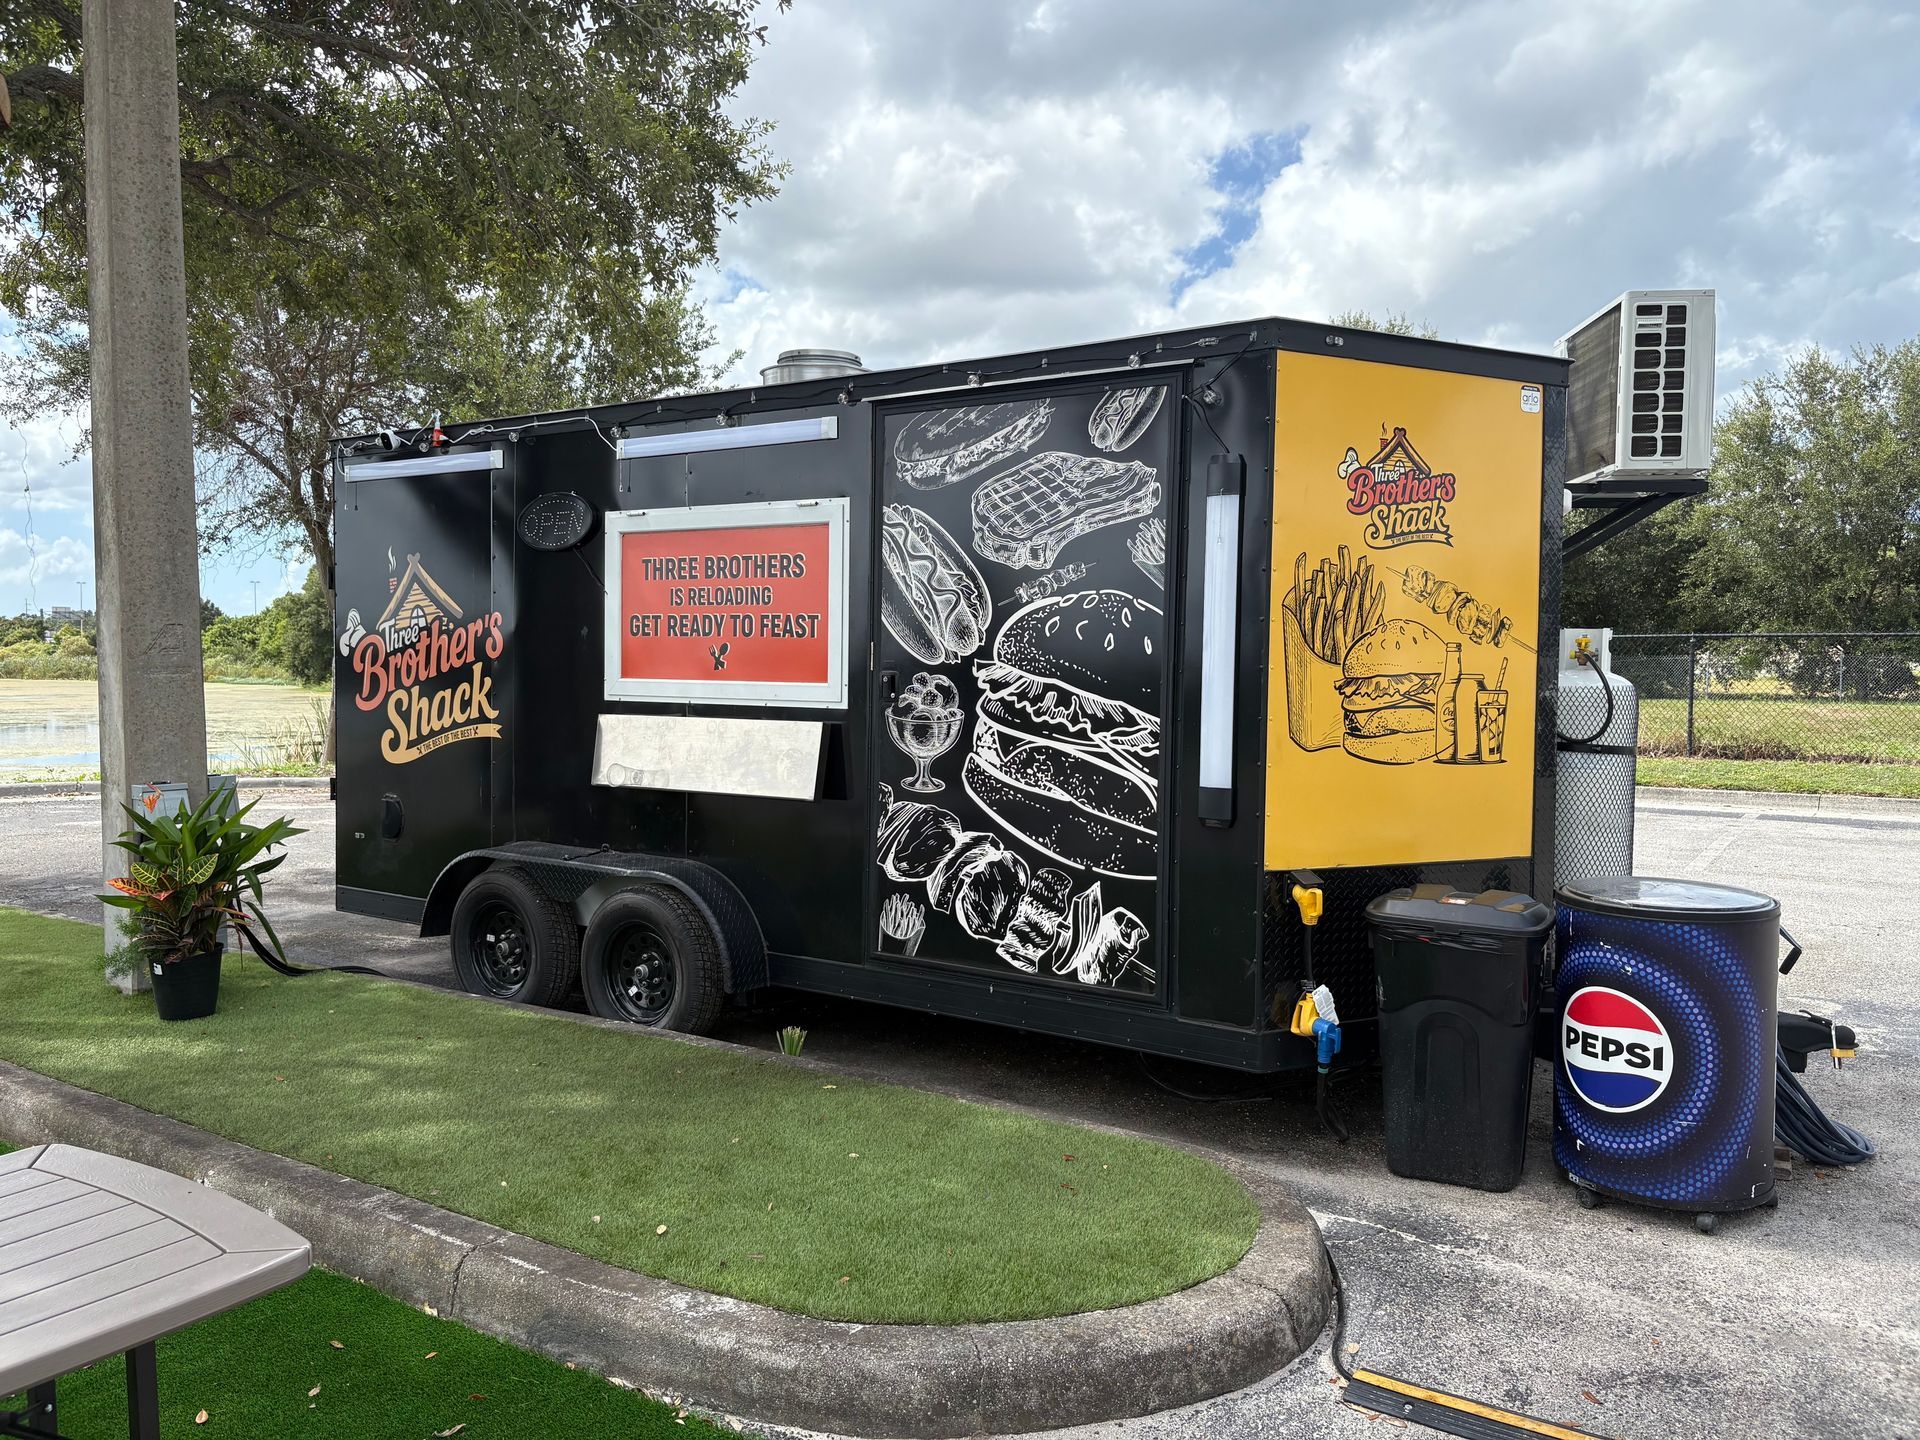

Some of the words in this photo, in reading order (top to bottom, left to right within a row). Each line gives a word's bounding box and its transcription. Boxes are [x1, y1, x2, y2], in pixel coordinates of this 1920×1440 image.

[1370, 463, 1400, 482] Three
[1347, 469, 1455, 514] Brother's
[525, 510, 581, 536] OPEN
[1365, 501, 1449, 549] Shack
[642, 556, 699, 581] THREE
[704, 553, 806, 579] BROTHERS
[670, 587, 684, 606] IS
[688, 585, 773, 606] RELOADING
[380, 618, 420, 652] Three
[629, 614, 663, 637] GET
[667, 613, 726, 638] READY
[729, 613, 755, 638] TO
[760, 613, 821, 638] FEAST
[352, 611, 504, 712] Brother's
[380, 661, 500, 764] Shack
[422, 740, 432, 752] THE
[431, 736, 444, 749] BEST
[443, 733, 450, 744] OF
[450, 730, 460, 742] THE
[460, 728, 473, 739] BEST
[1565, 1024, 1663, 1072] PEPSI
